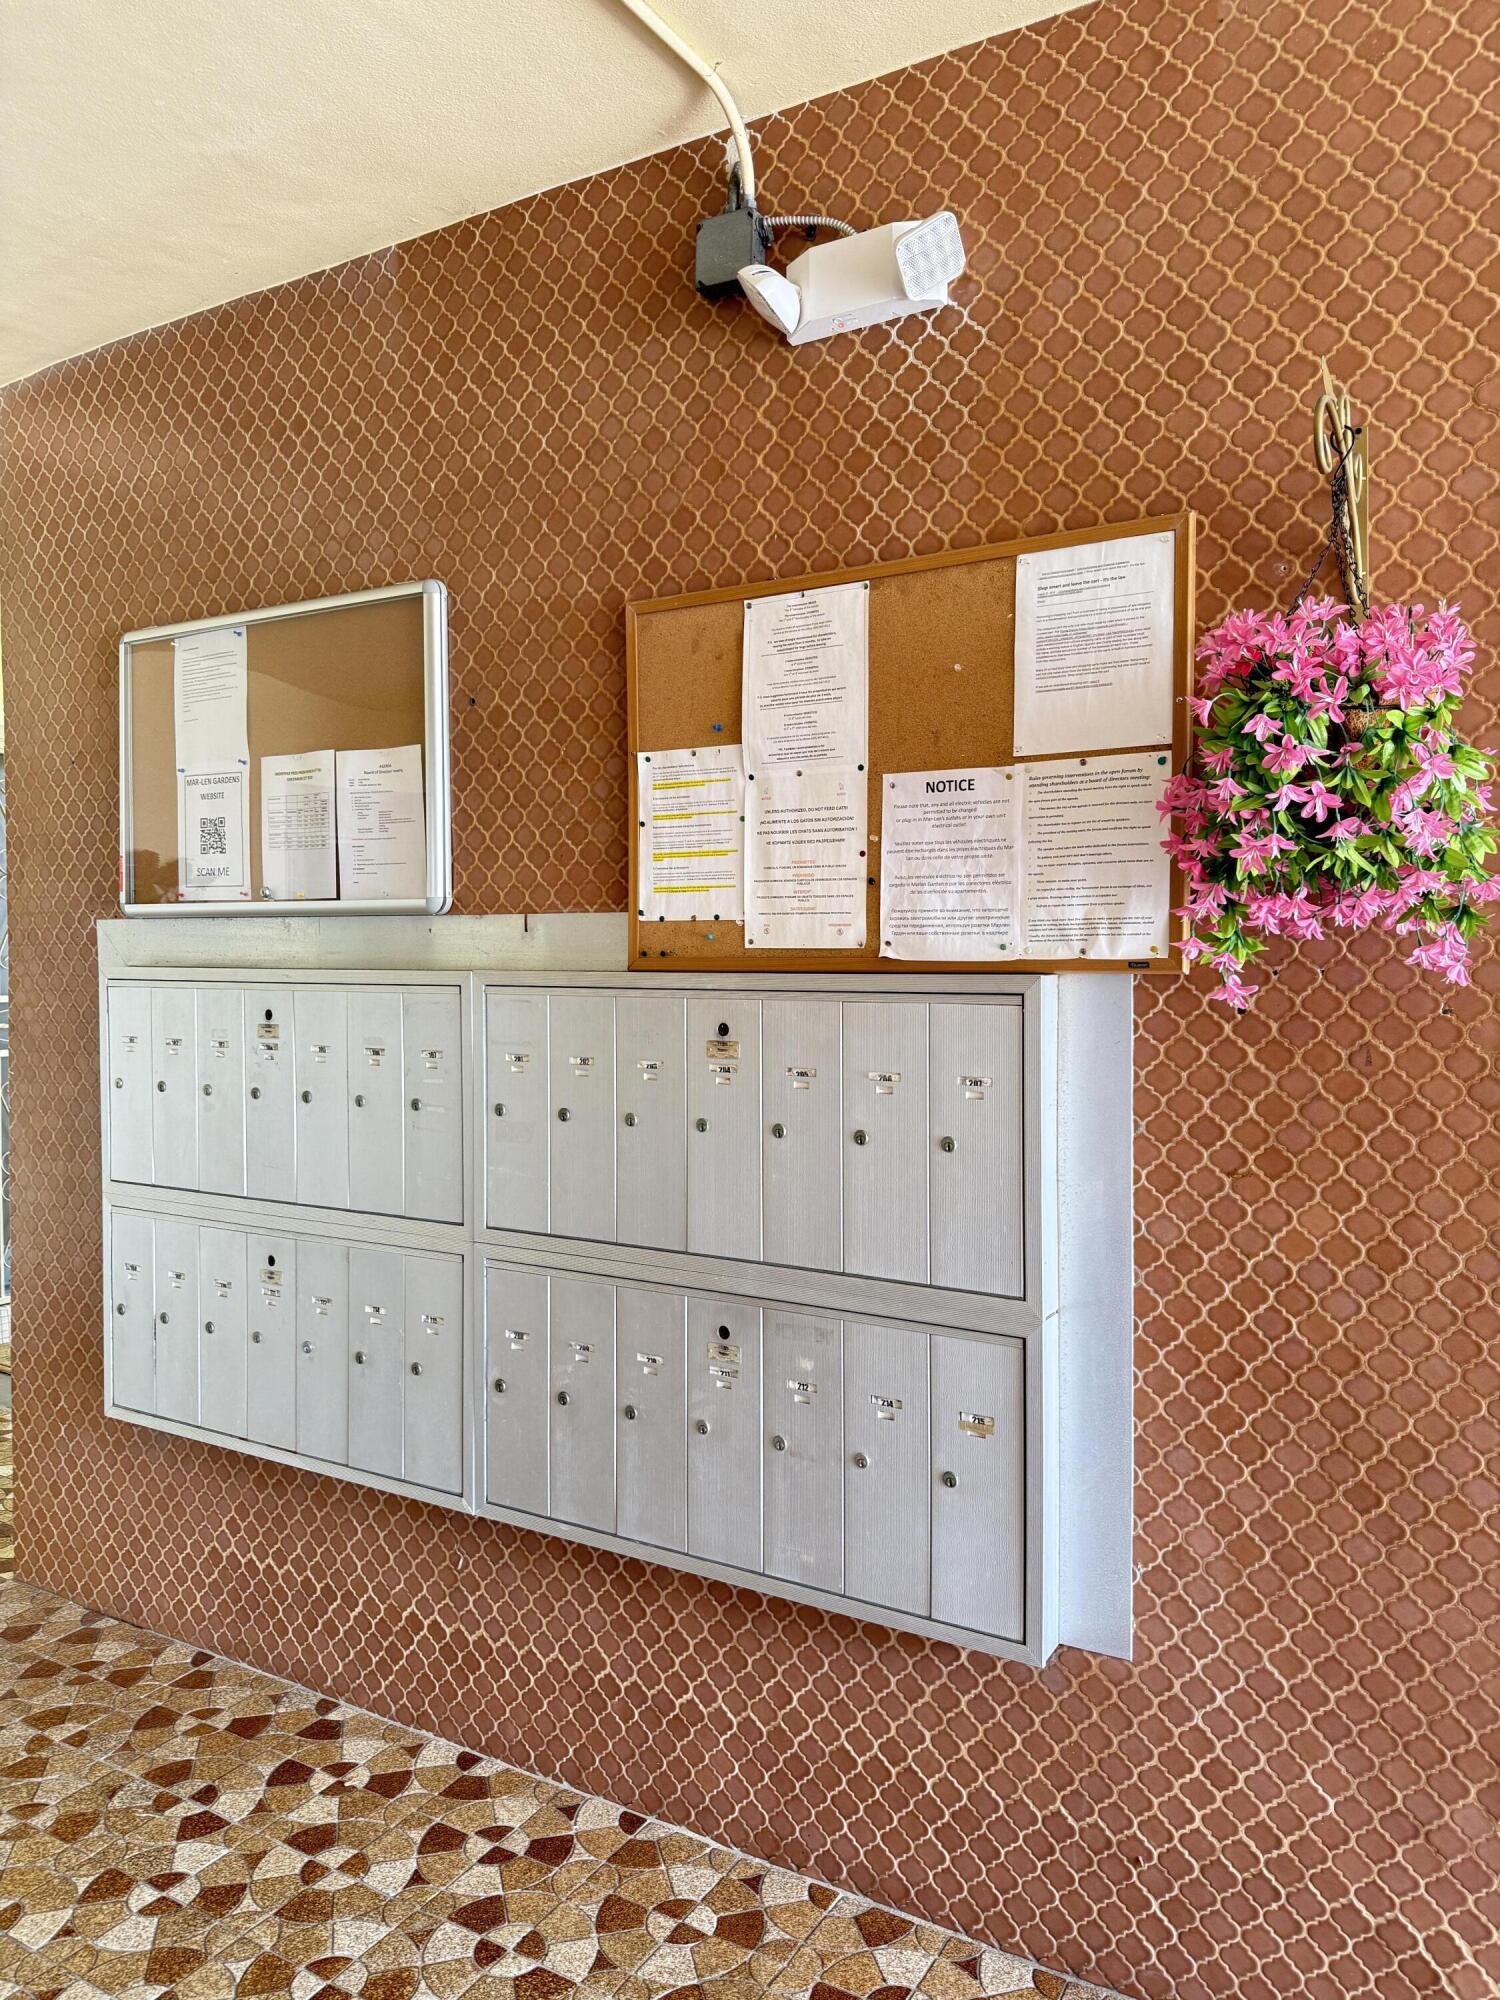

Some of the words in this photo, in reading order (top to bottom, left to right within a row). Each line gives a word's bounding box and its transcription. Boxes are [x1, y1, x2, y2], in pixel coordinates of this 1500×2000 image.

[187, 778, 211, 786] MAR-LEN
[212, 776, 240, 784] GARDENS
[926, 779, 975, 793] NOTICE
[200, 792, 224, 800] WEBSITE
[196, 867, 216, 876] SCAN
[218, 867, 230, 876] ME
[580, 1057, 589, 1065] 202
[798, 1382, 808, 1391] 212
[972, 1416, 985, 1424] 215
